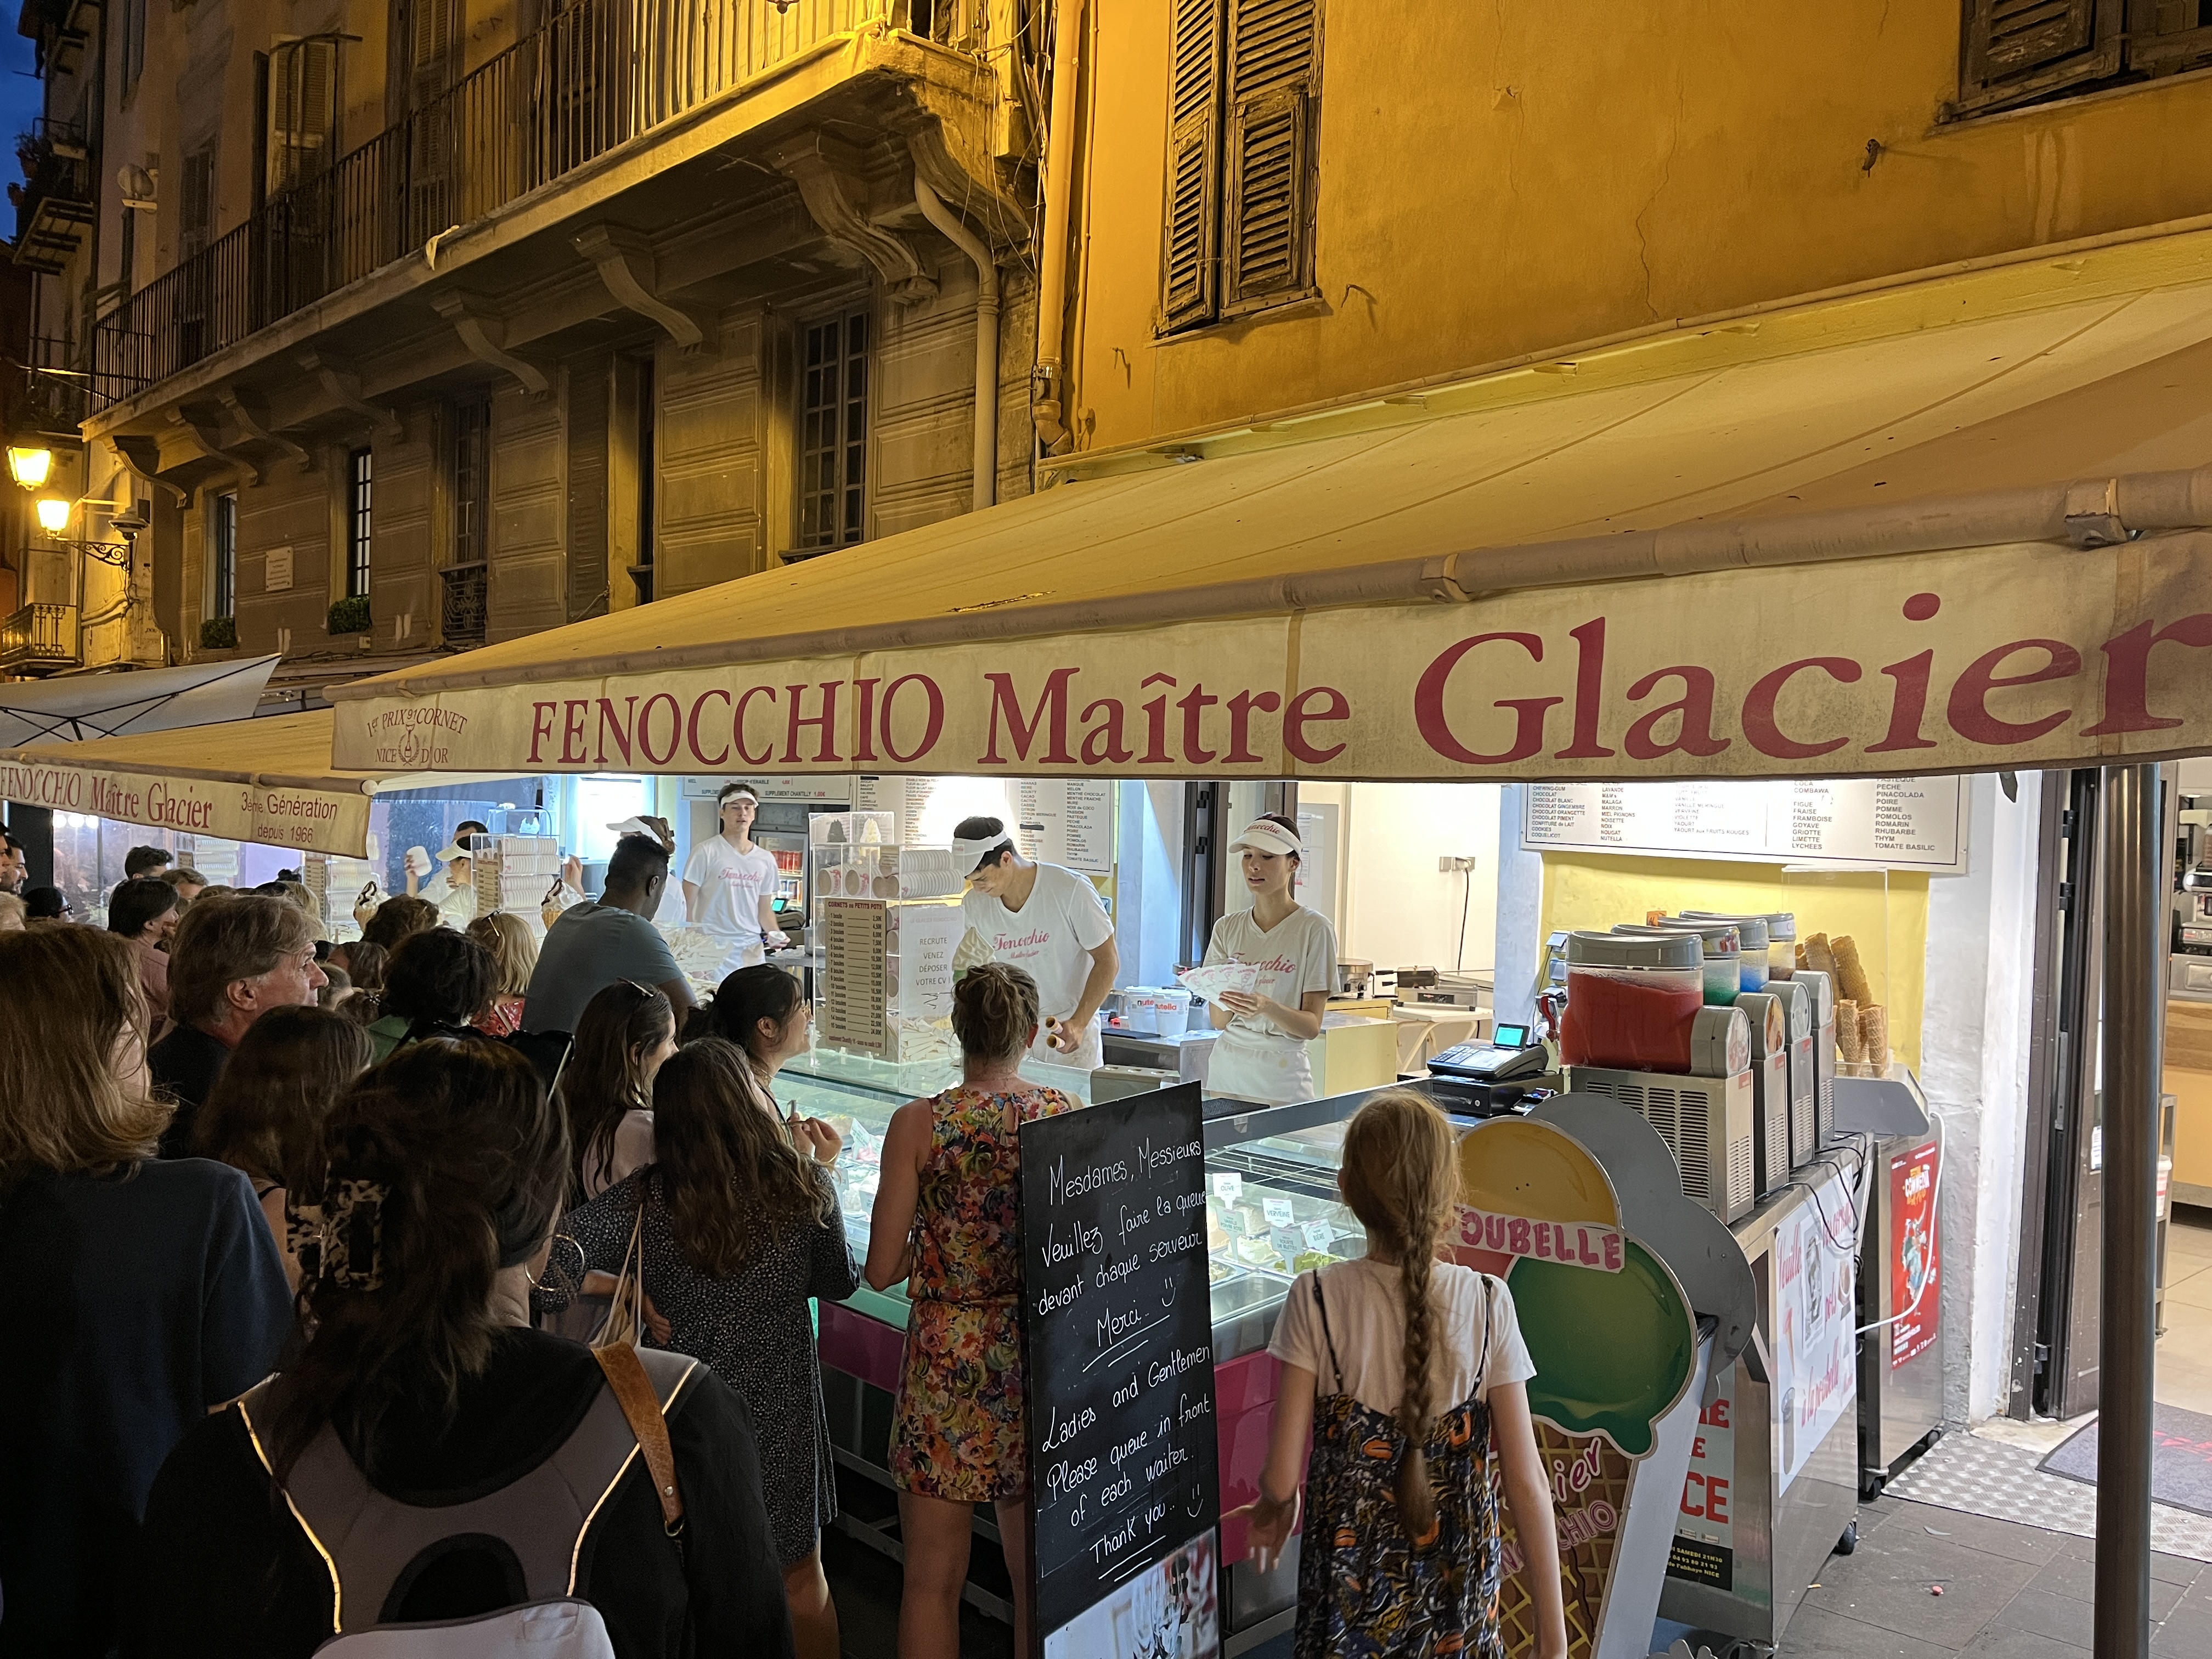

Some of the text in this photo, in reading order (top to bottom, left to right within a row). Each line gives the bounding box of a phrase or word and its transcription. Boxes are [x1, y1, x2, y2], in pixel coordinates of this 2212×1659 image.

[526, 592, 2212, 767] FENOCCHIO Maître Glacier
[382, 709, 408, 730] PRIX
[408, 709, 417, 720] 91
[416, 708, 467, 735] CORNET
[375, 748, 397, 763] NICE
[0, 766, 212, 828] FENOCCHIO Maître Glacier
[241, 792, 338, 820] 3ème Génération
[257, 825, 313, 843] depuis 1966
[919, 937, 947, 945] RECRUTE
[916, 978, 936, 986] VOTRE
[919, 964, 947, 973] DÉPOSER
[1138, 1137, 1202, 1179] Messieurs
[1042, 1190, 1206, 1268] Veuillez faire la queue
[1266, 1210, 1290, 1218] VERVEINE
[1454, 1206, 1622, 1271] OUBELLE
[1038, 1232, 1203, 1316] devant chaque serveur
[1042, 1345, 1210, 1453] Ladies and Gentlemen
[1046, 1393, 1211, 1502] Please queue in front
[1070, 1493, 1087, 1527] of
[1101, 1471, 1132, 1507] each
[1089, 1517, 1137, 1564] Thank
[1677, 1547, 1723, 1563] SAMEDI 21H30
[1704, 1570, 1720, 1578] NICE
